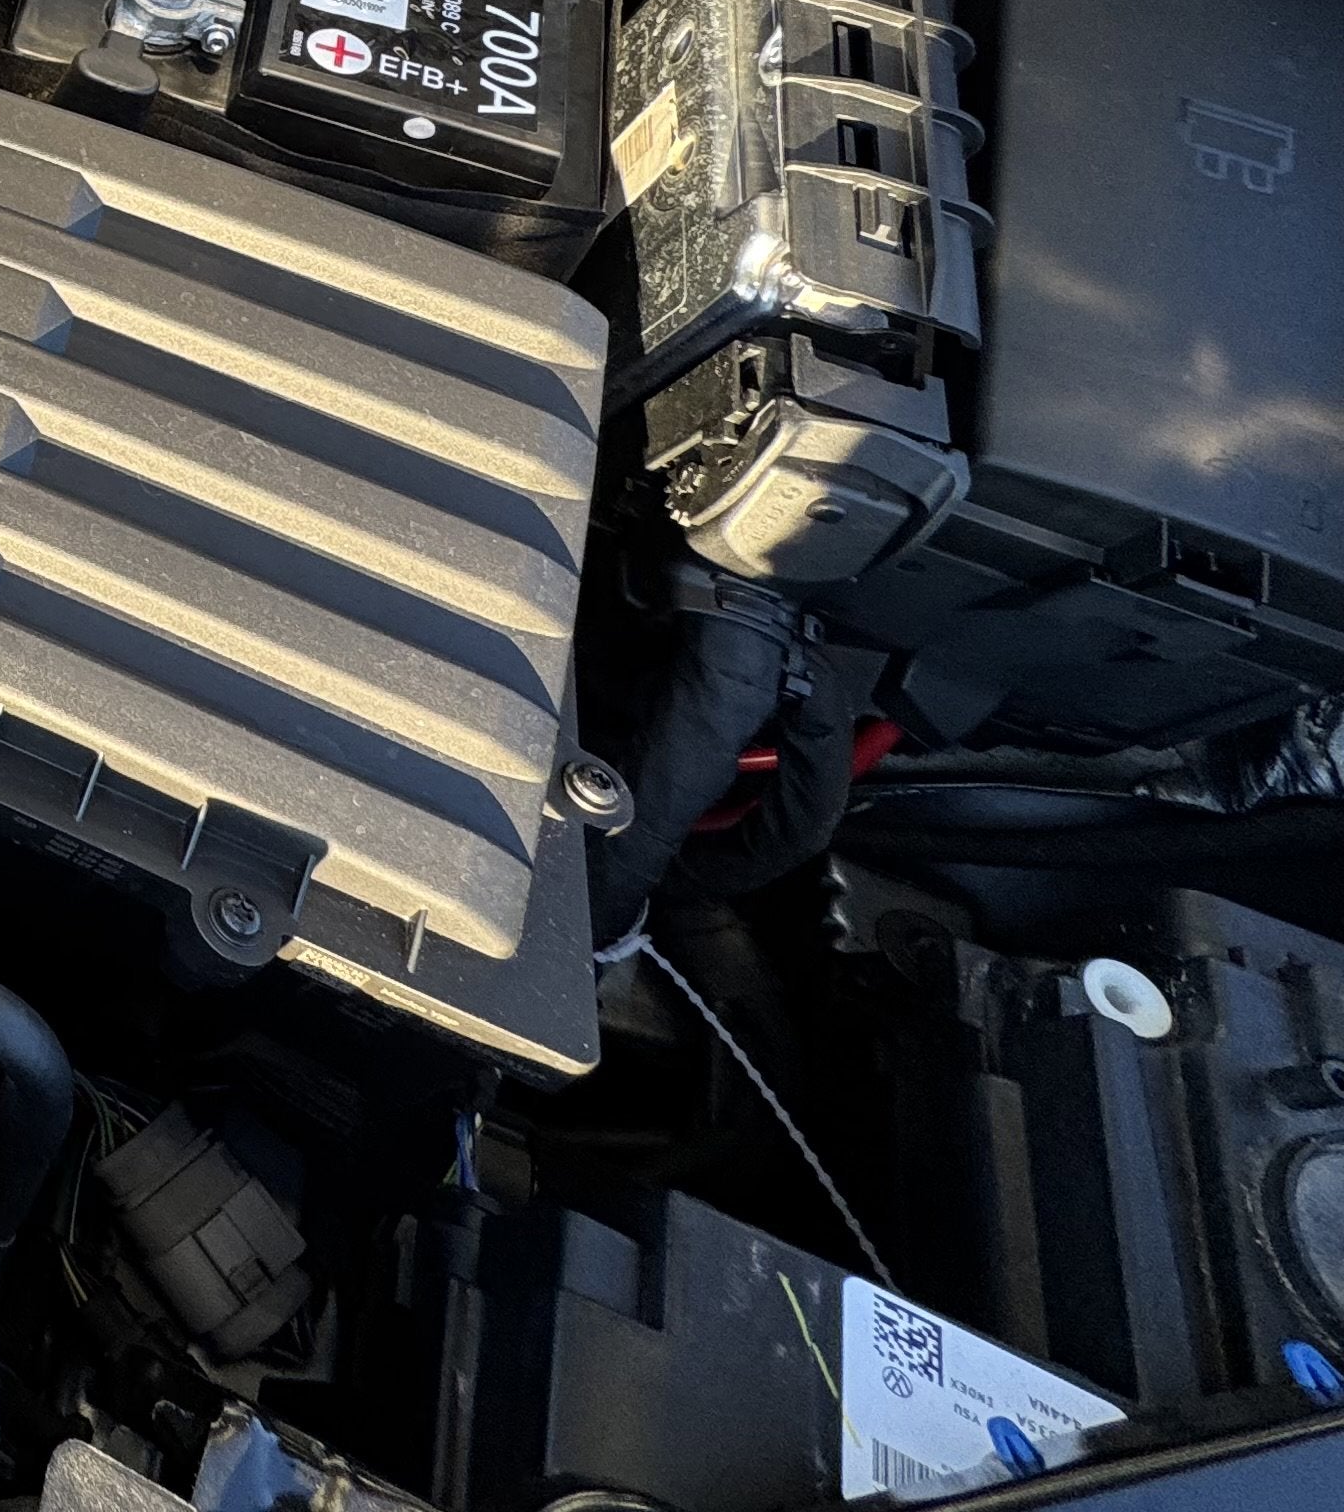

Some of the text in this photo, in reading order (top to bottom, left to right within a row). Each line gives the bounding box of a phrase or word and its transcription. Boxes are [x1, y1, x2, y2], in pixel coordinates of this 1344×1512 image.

[440, 21, 459, 34] C
[378, 54, 468, 96] EFB+
[476, 4, 540, 112] 700A
[949, 1377, 994, 1407] INDEX
